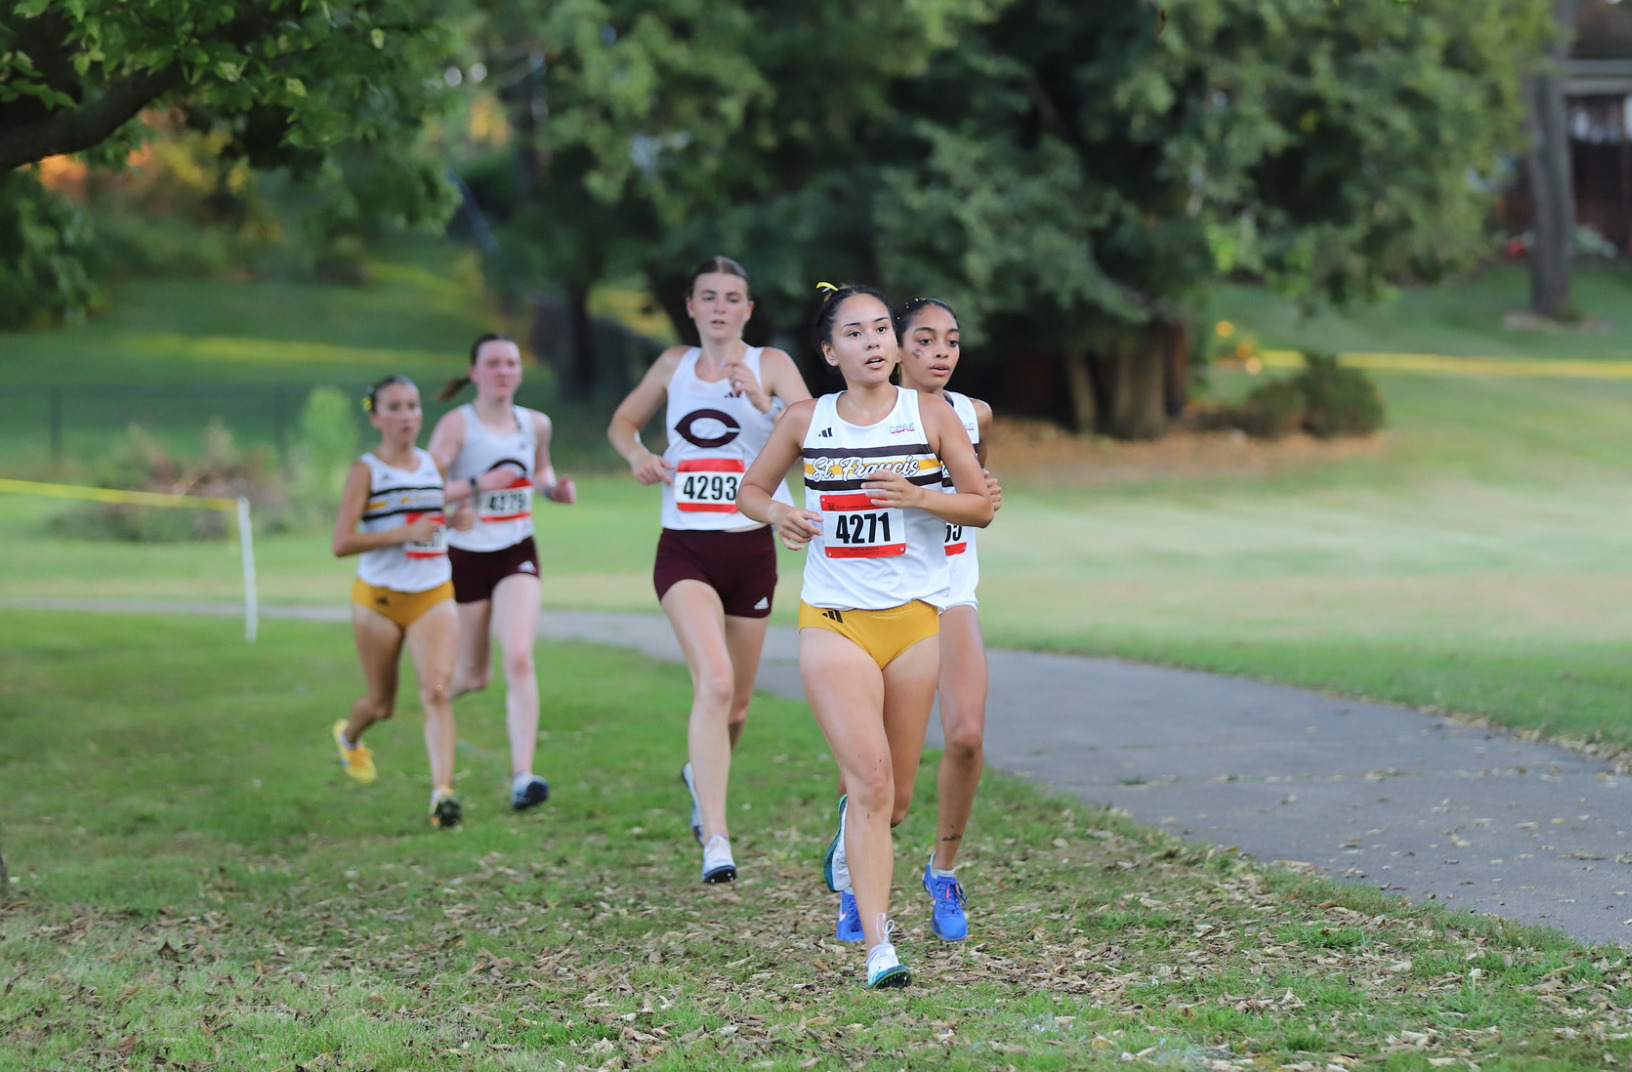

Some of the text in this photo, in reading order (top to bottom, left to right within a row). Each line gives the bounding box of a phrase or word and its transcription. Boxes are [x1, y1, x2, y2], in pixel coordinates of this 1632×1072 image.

[813, 456, 835, 482] St.
[683, 475, 738, 500] 4293
[835, 512, 891, 543] 4271
